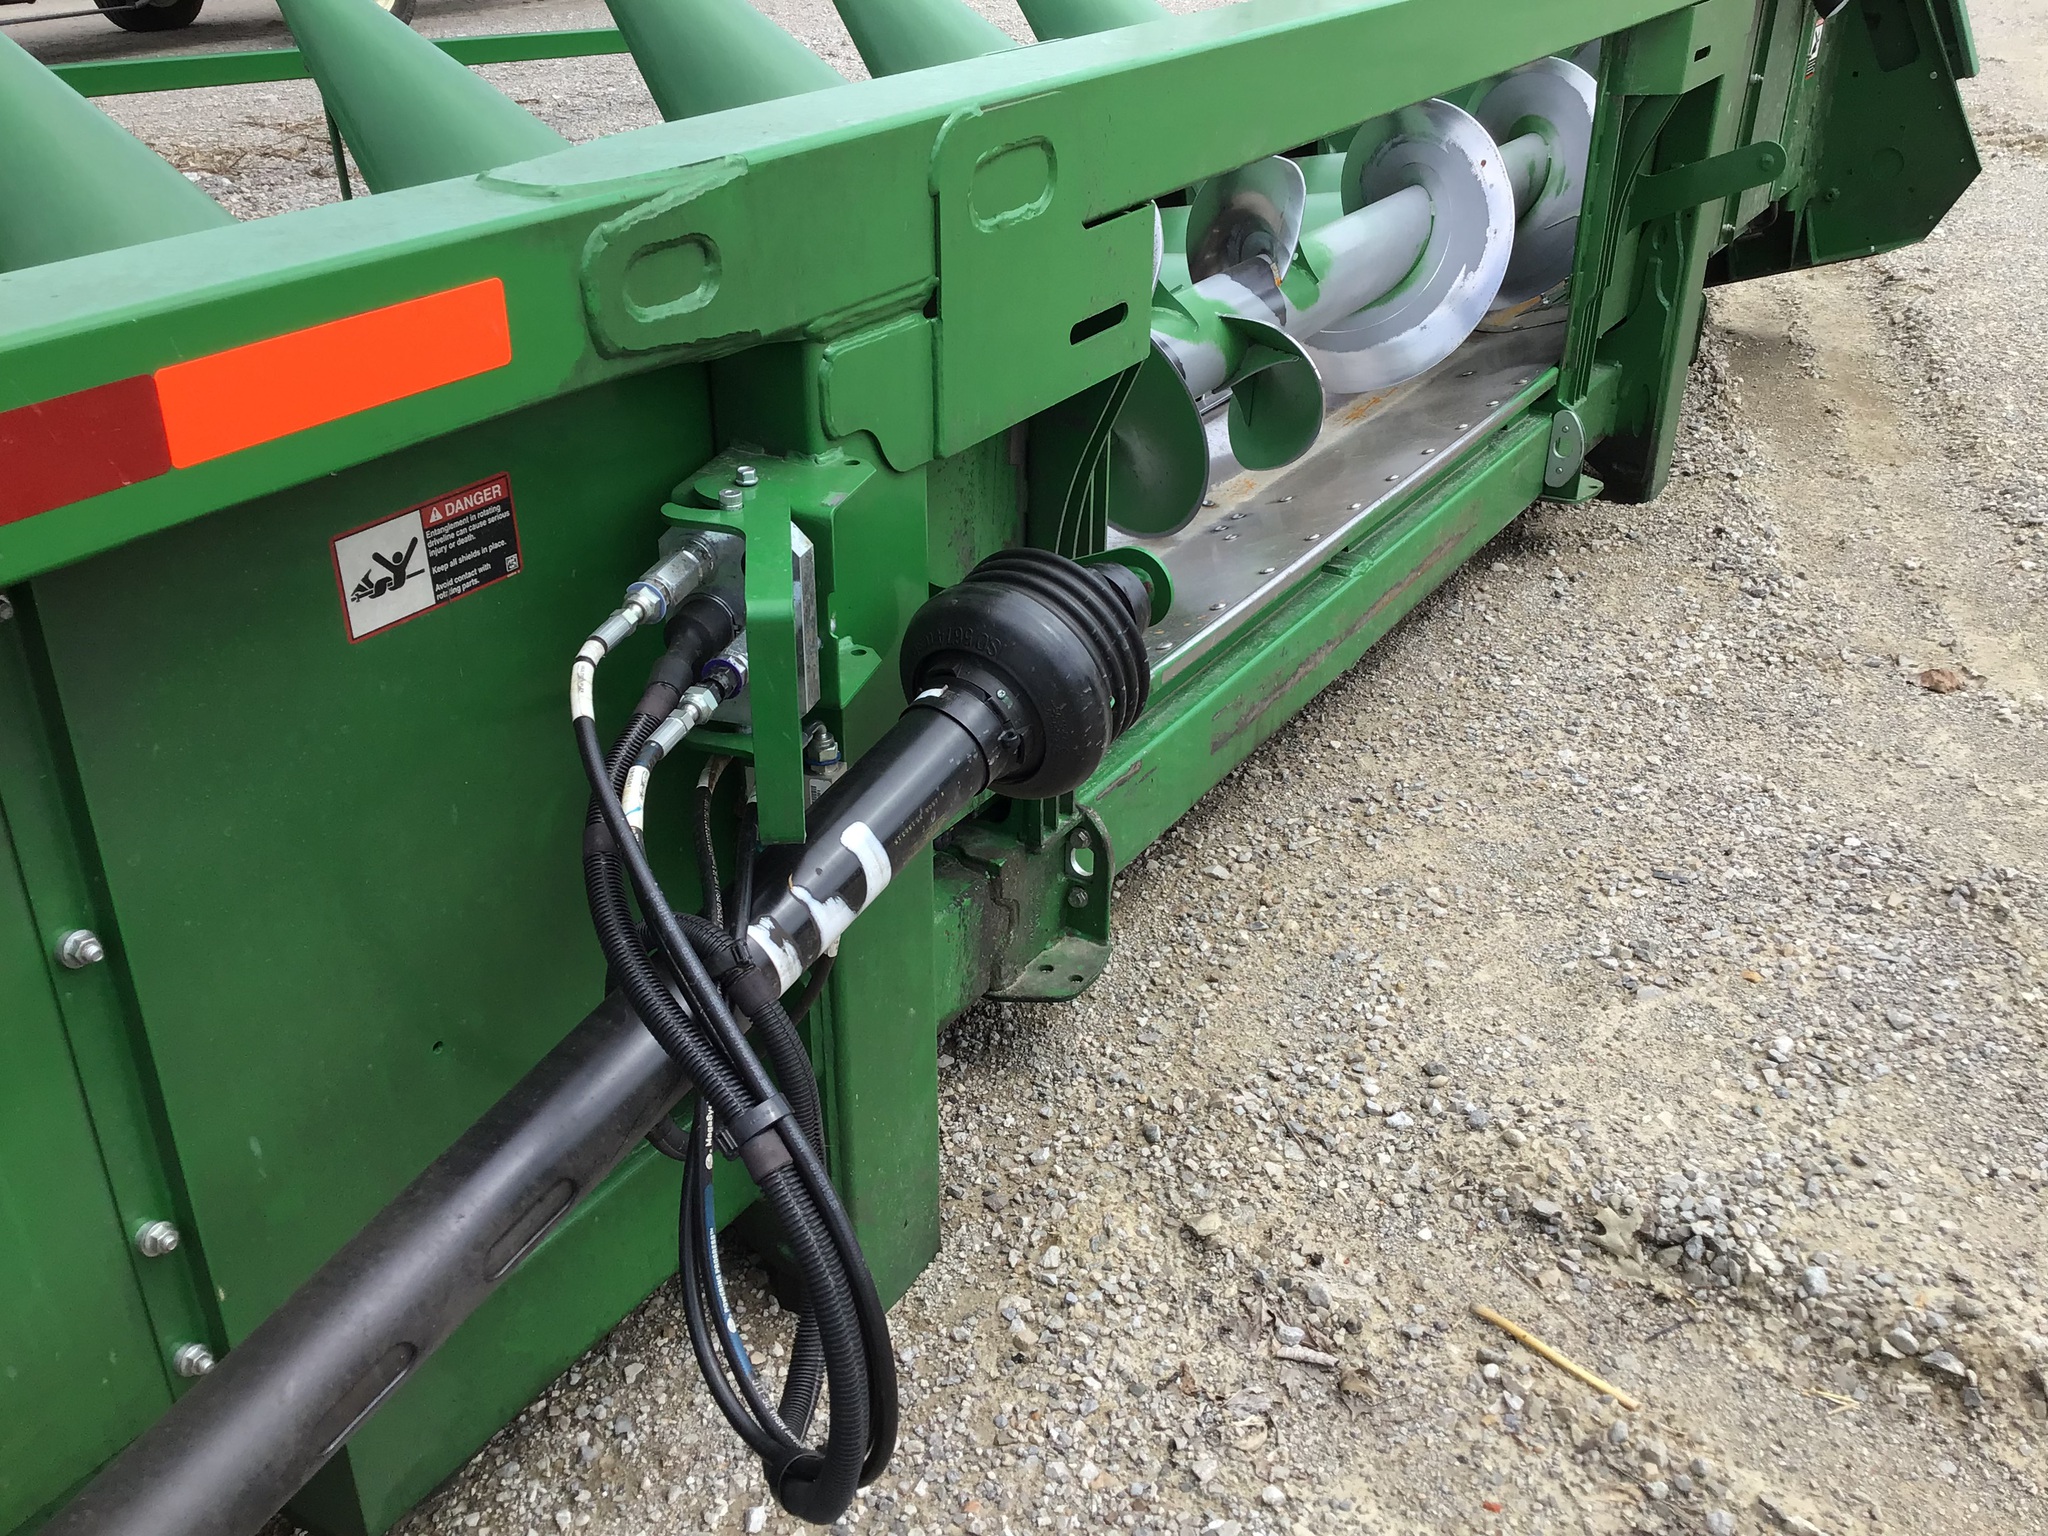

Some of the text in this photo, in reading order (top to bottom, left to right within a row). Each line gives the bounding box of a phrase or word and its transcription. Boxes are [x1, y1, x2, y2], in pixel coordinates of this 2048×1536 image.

[445, 484, 501, 516] DANGER
[426, 516, 469, 539] Entanglement
[477, 505, 501, 518] rotating
[427, 510, 510, 548] driveline can cause serious
[428, 533, 476, 557] injury or death.
[432, 563, 449, 574] Keep
[458, 549, 481, 564] shields
[481, 546, 488, 554] in
[489, 539, 507, 553] place.
[435, 577, 453, 592] Avoid
[454, 568, 477, 583] contact
[478, 562, 491, 574] with
[462, 577, 480, 590] parts.
